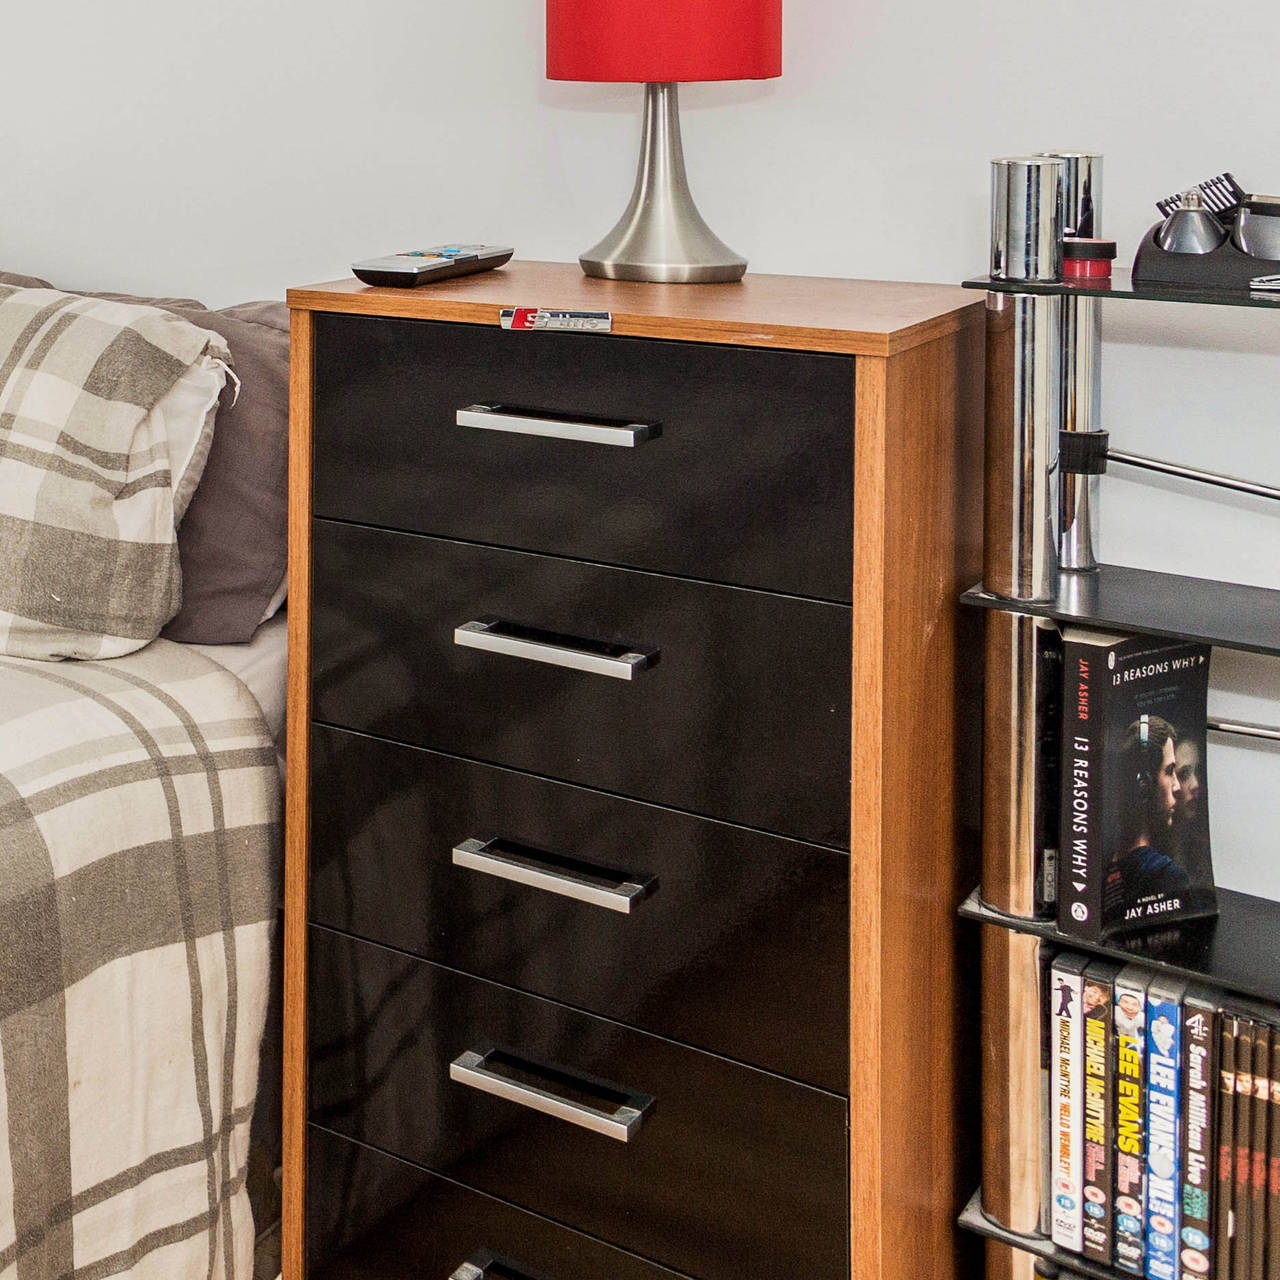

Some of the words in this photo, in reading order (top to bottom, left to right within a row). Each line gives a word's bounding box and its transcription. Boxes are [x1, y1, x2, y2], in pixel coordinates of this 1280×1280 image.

[1079, 658, 1089, 679] JAY
[1112, 673, 1121, 686] 13
[1123, 661, 1169, 682] REASONS
[1172, 656, 1196, 670] WHY
[1078, 682, 1089, 720] ASHER
[1074, 736, 1089, 752] 13
[1073, 758, 1089, 834] REASONS
[1071, 839, 1088, 878] WHY
[1124, 906, 1143, 920] JAY
[1146, 899, 1181, 915] ASHER
[1059, 1018, 1071, 1054] MICHAEL
[1086, 1017, 1105, 1075] MICHAEL
[1119, 1034, 1140, 1078] LEE
[1150, 1053, 1175, 1091] LEE
[1189, 1043, 1207, 1089] Sarah
[1059, 1056, 1071, 1100] McINTYRE
[1085, 1075, 1105, 1145] McINTYRE
[1118, 1079, 1140, 1155] EVANS
[1188, 1089, 1207, 1151] Millican
[1187, 1151, 1207, 1185] Live
